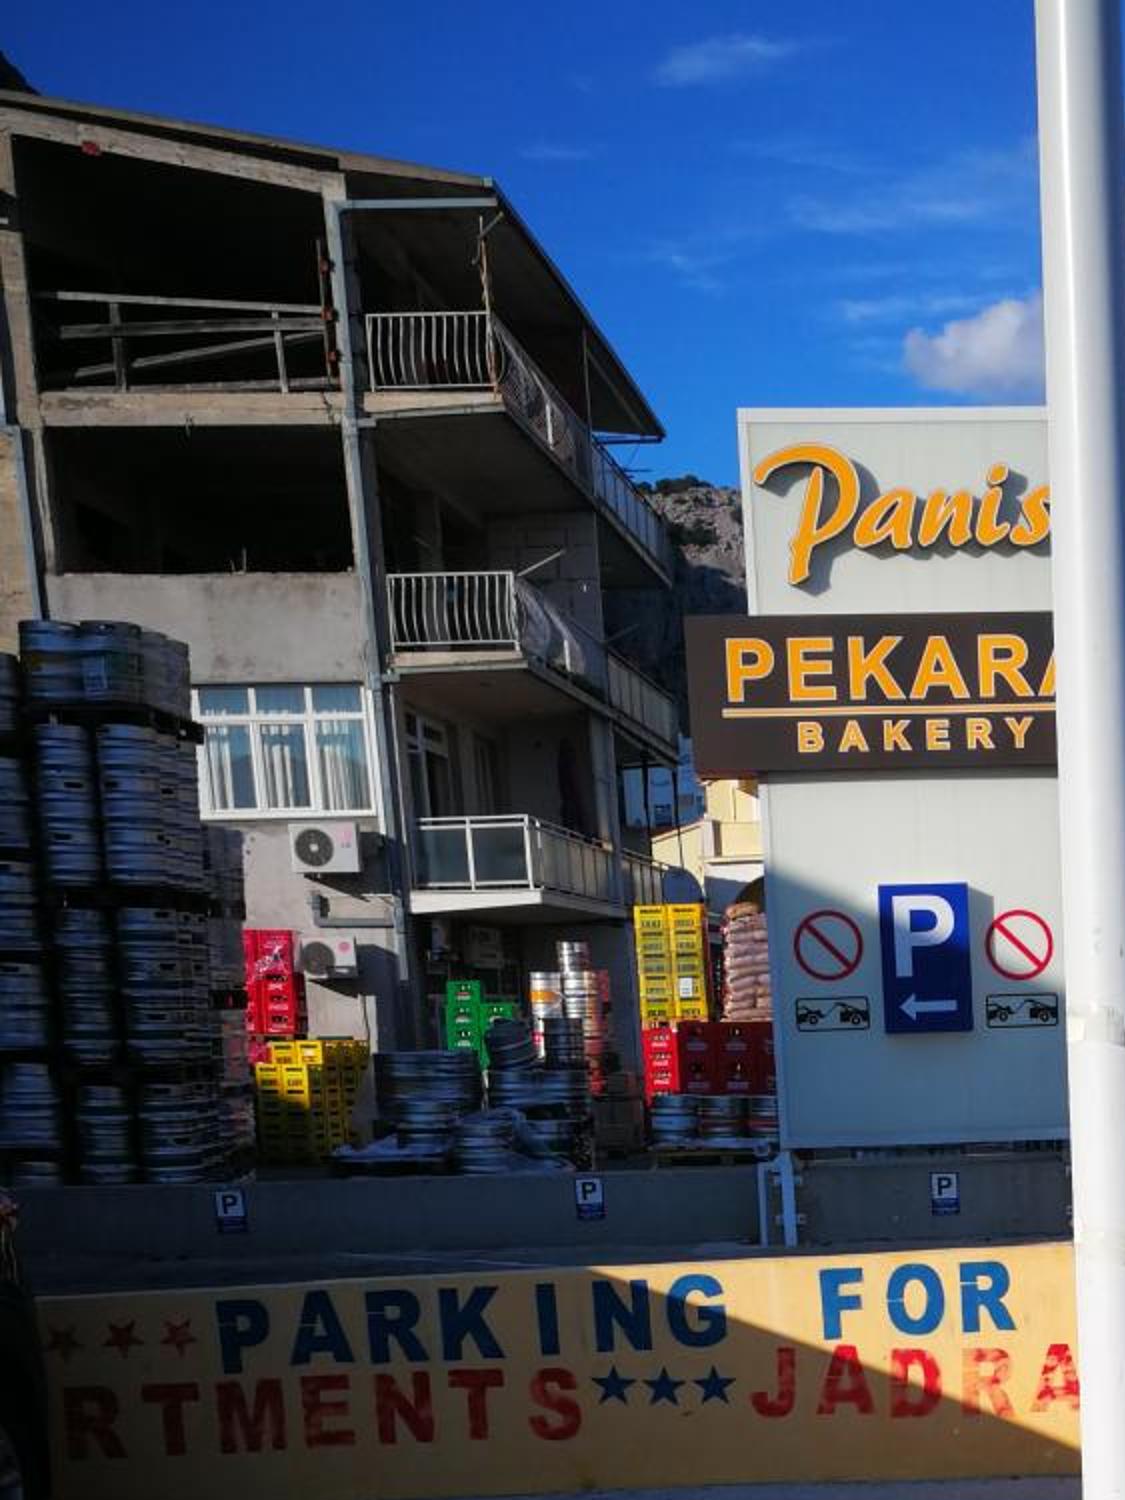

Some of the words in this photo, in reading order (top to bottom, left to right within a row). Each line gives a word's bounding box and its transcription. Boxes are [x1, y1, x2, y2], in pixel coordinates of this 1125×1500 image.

[753, 442, 1052, 585] Panis
[797, 717, 1034, 753] BAKERY
[892, 895, 956, 979] P
[222, 1195, 237, 1215] P
[582, 1182, 596, 1201] P
[938, 1177, 952, 1197] P
[215, 1273, 729, 1374] PARKING
[819, 1260, 1017, 1341] FOR
[62, 1367, 583, 1461] RTMENTS
[751, 1342, 1082, 1419] JADRA
